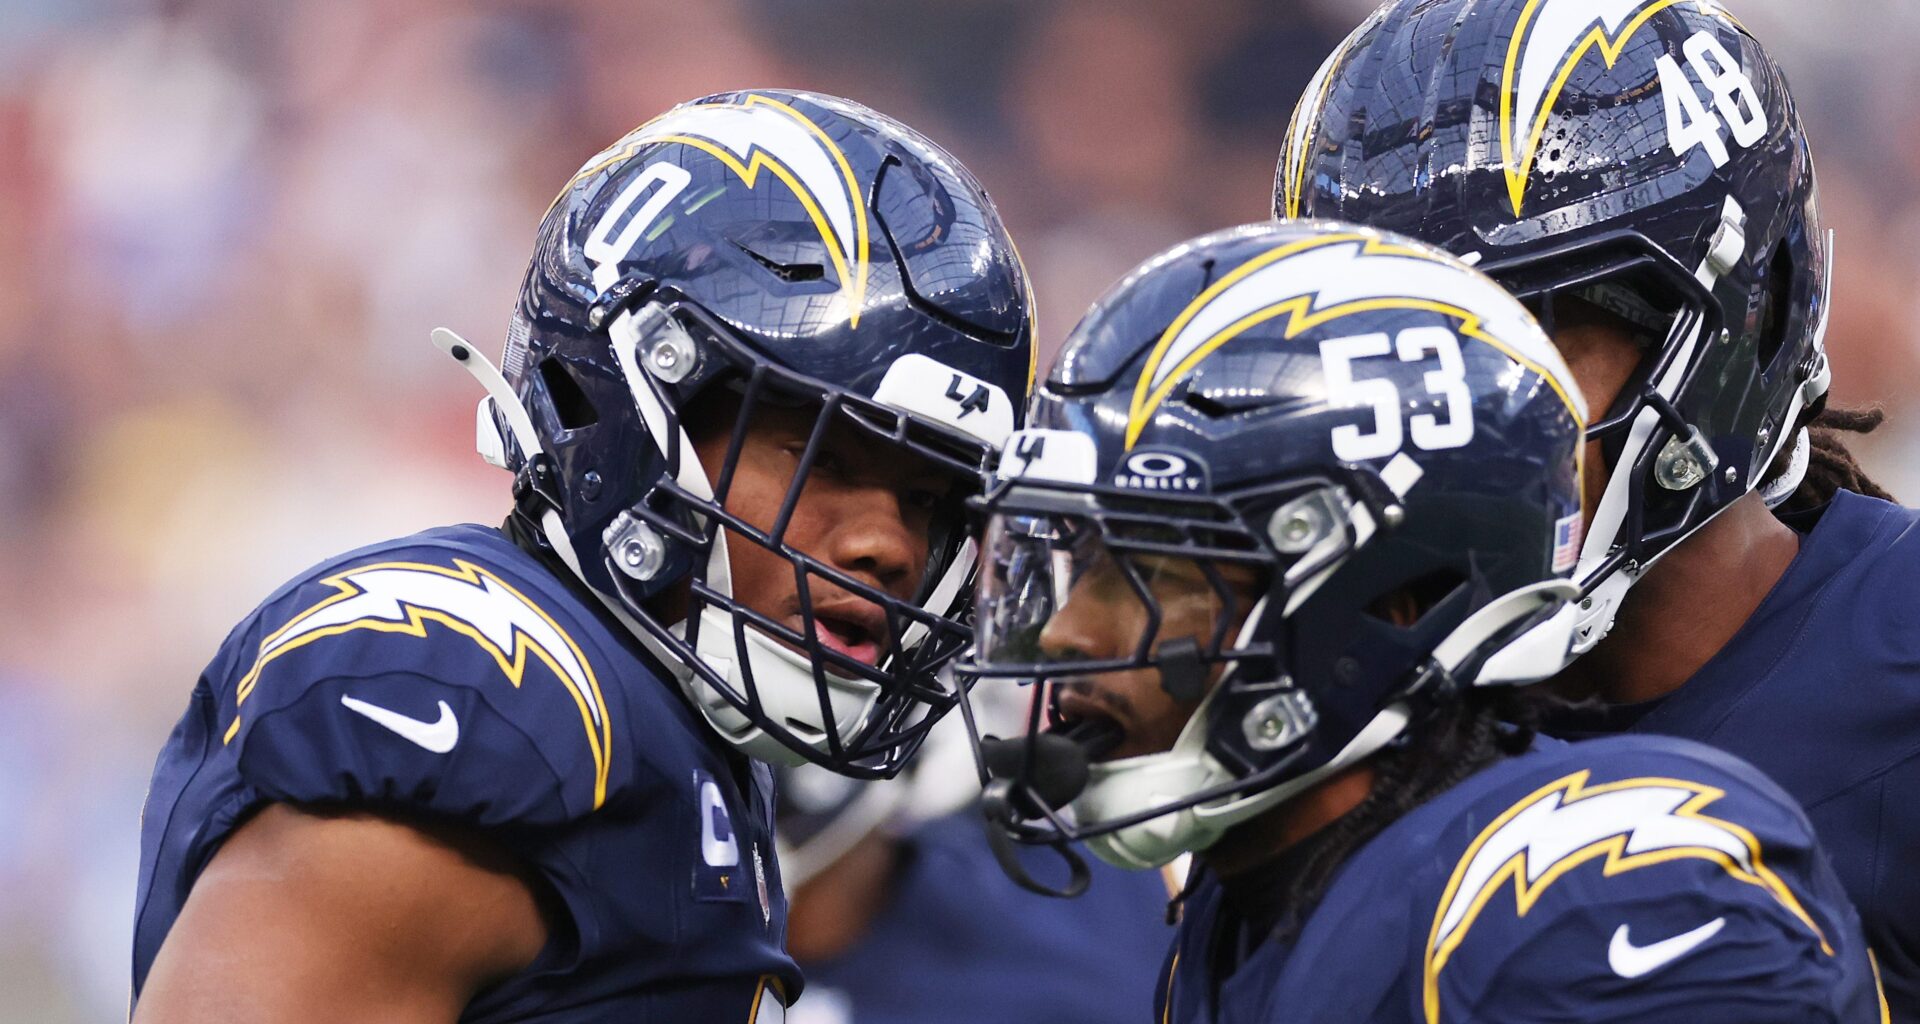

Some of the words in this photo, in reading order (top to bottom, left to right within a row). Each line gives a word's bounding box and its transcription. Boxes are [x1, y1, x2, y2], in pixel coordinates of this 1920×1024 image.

[1655, 30, 1768, 169] 48
[584, 161, 692, 264] 0
[945, 374, 990, 419] LA
[1319, 326, 1475, 462] 53
[701, 781, 739, 867] C
